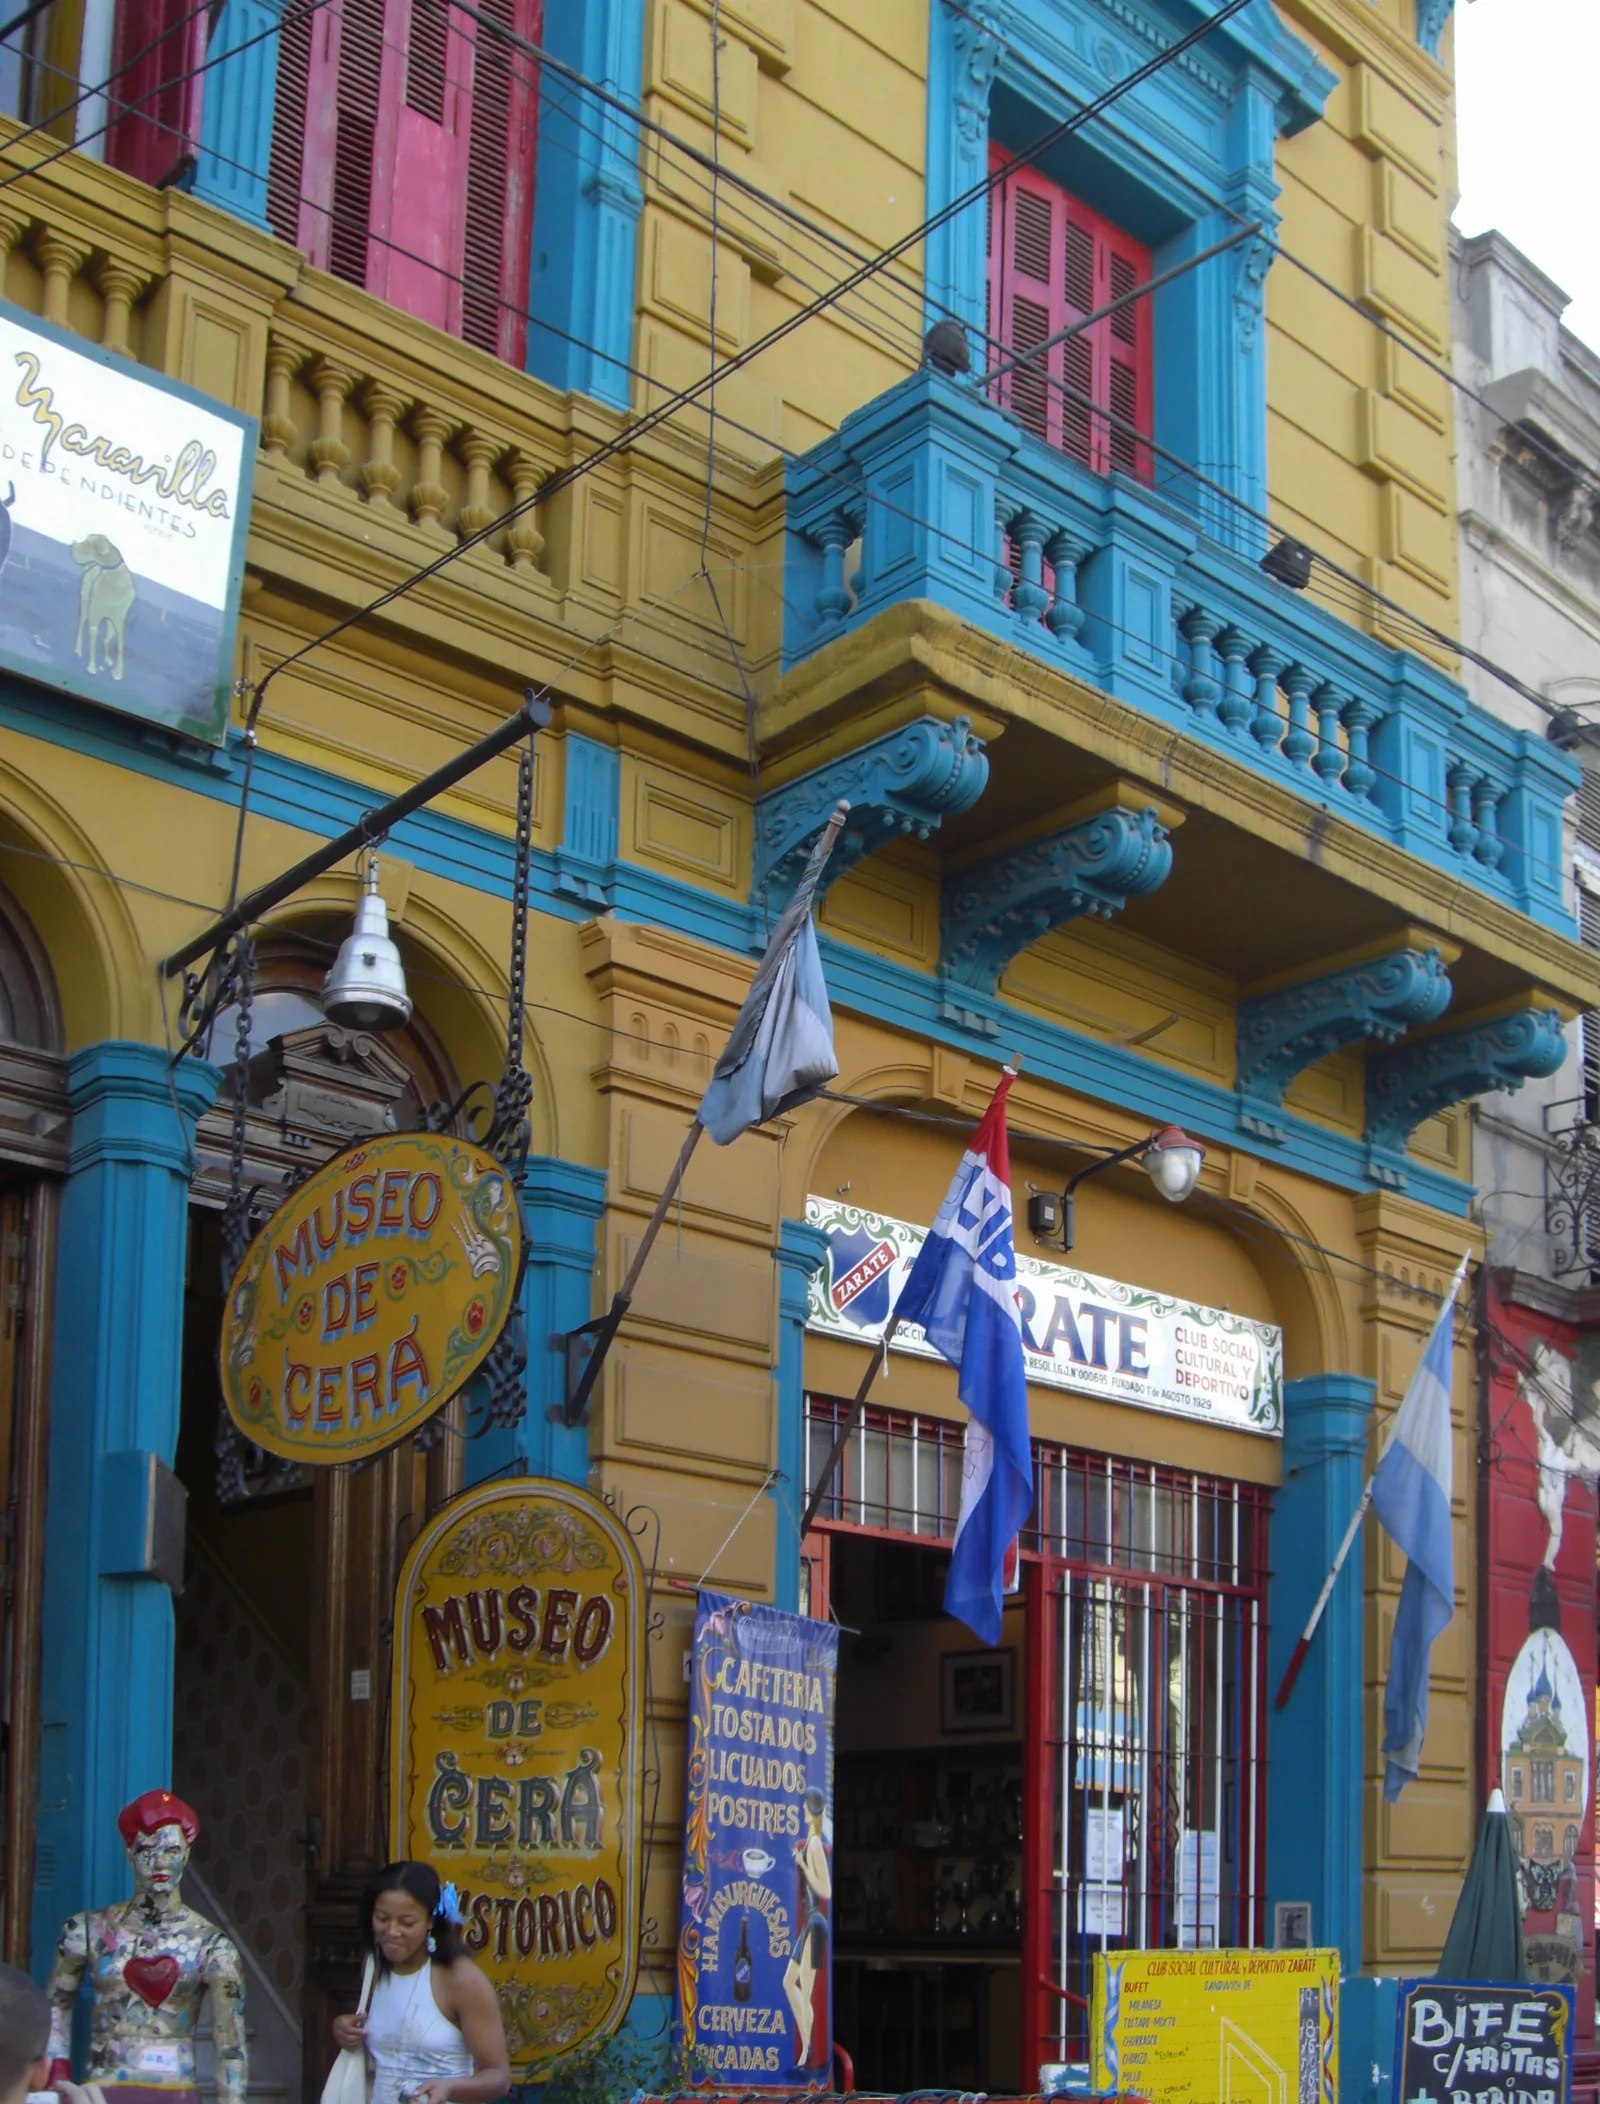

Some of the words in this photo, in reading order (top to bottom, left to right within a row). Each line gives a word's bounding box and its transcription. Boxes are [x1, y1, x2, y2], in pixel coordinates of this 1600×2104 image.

[14, 352, 230, 519] Maravilla
[272, 1168, 442, 1303] MUSEO
[322, 1262, 380, 1340] DE
[836, 1249, 889, 1302] ZARATE
[1174, 1326, 1208, 1350] CLUB
[1212, 1337, 1255, 1362] SOCIAL
[1175, 1348, 1238, 1379] CULTURAL
[1242, 1365, 1251, 1381] Y
[283, 1314, 431, 1432] CERA
[1175, 1368, 1249, 1401] DEPORTIVO
[1161, 1388, 1191, 1405] AGOSTO
[1192, 1396, 1213, 1410] 1929
[421, 1585, 615, 1678] MUSEO
[719, 1657, 824, 1714] CAFETERIA
[486, 1699, 544, 1739] DE
[712, 1704, 817, 1755] TOSTADOS
[708, 1748, 806, 1795] LICUADOS
[427, 1748, 606, 1852] CERA
[707, 1791, 800, 1839] POSTRES
[455, 1876, 617, 1962] ISTÓRICO
[701, 1880, 791, 1973] HAMBURGUESAS
[1124, 1982, 1149, 1993] BUFET
[1146, 1961, 1168, 1977] CLUB
[1168, 1960, 1197, 1976] SOCIAL
[1199, 1959, 1240, 1975] CULTURAL
[1248, 1959, 1285, 1974] DEPORTIVO
[698, 2005, 787, 2038] CERVEZA
